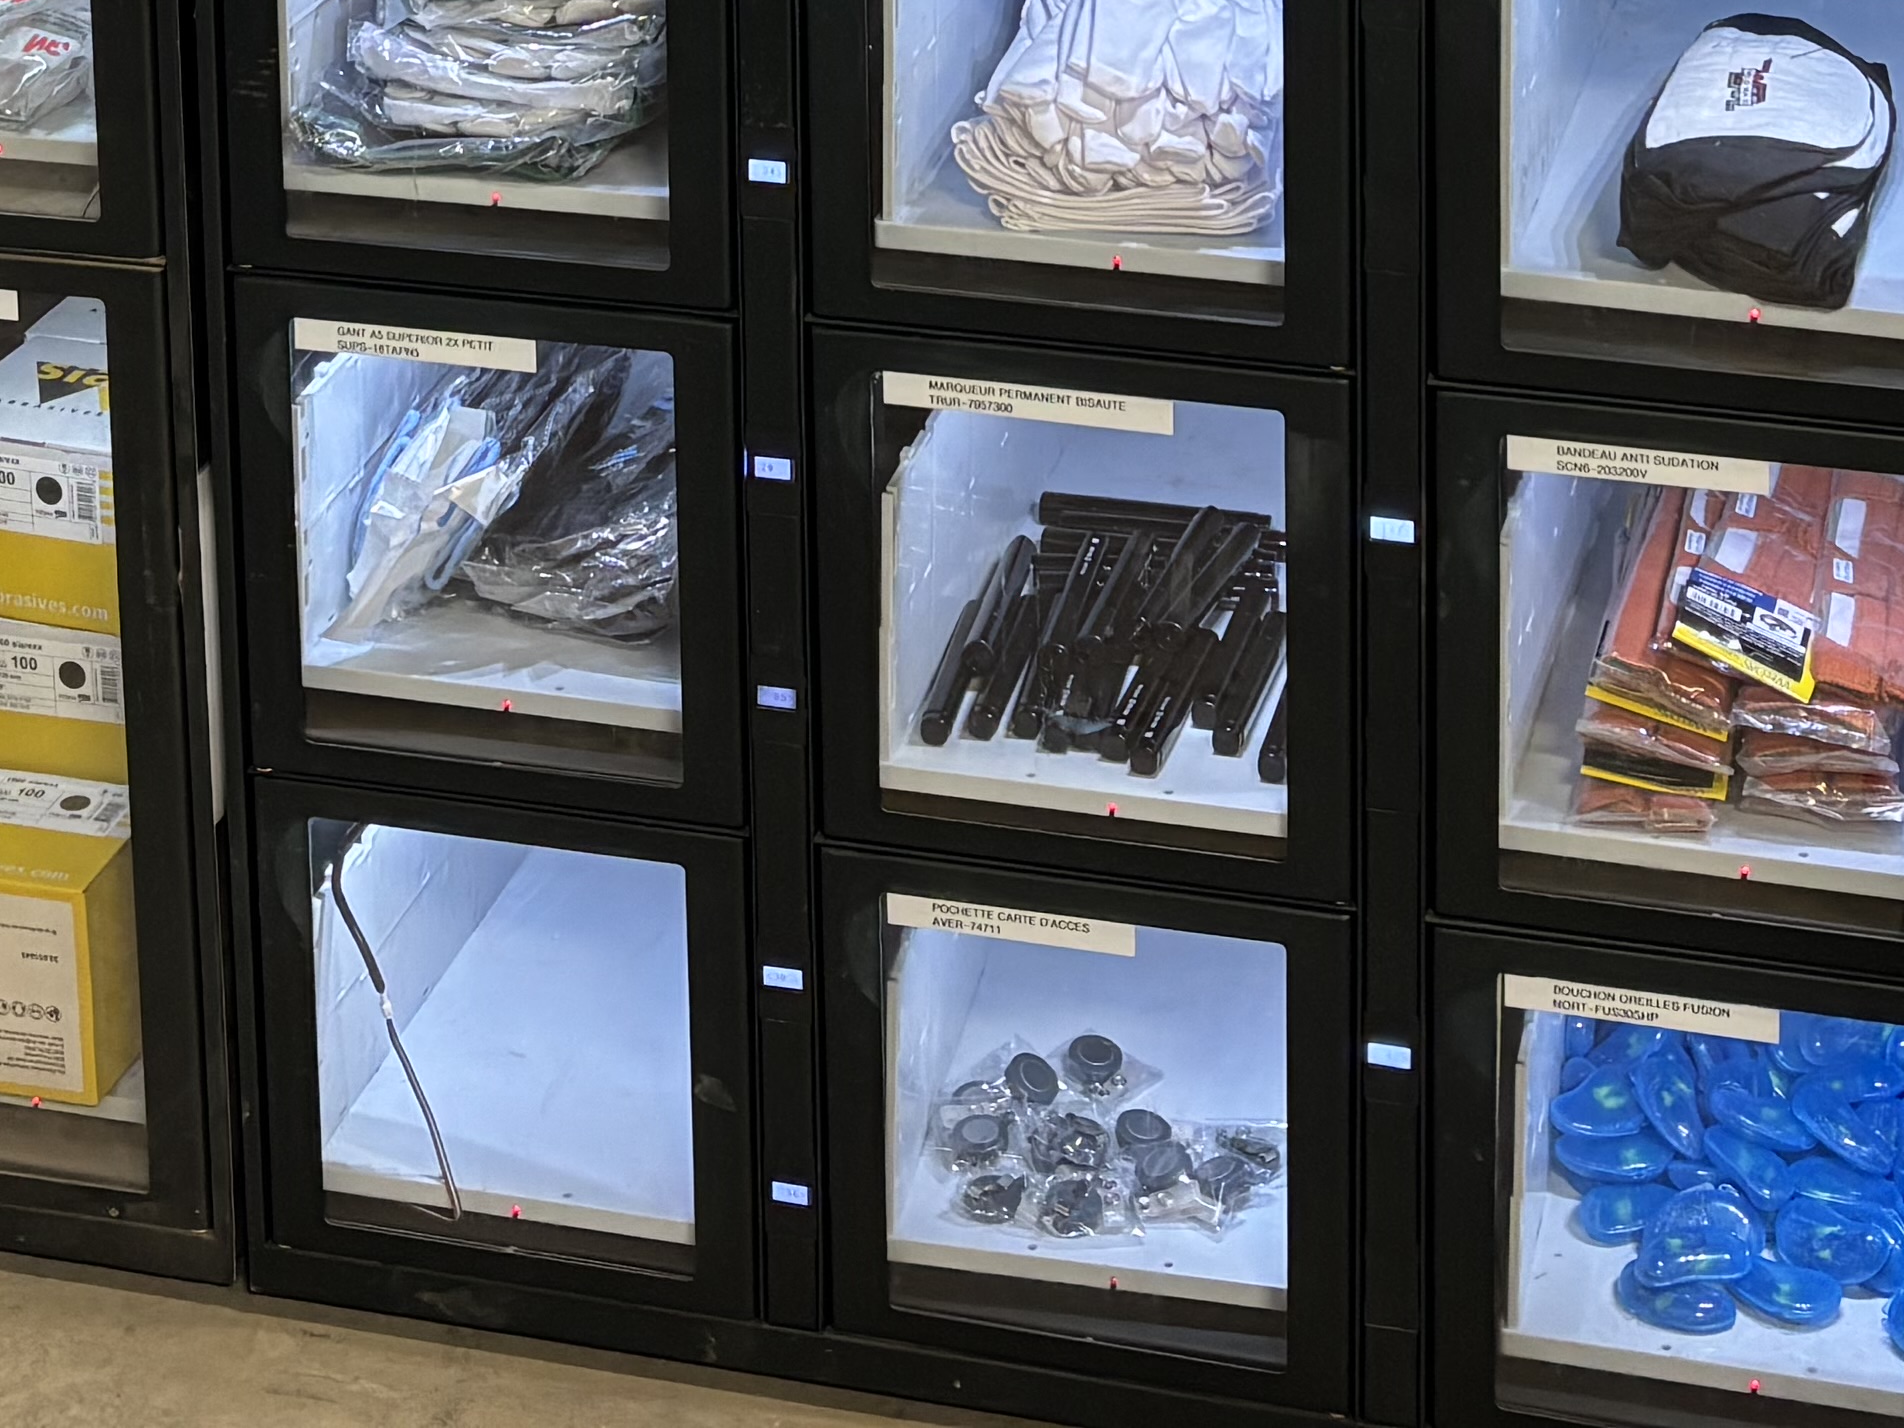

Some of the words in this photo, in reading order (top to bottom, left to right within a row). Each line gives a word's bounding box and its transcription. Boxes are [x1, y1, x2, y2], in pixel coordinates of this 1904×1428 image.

[928, 380, 996, 396] MARQUEUR
[998, 388, 1072, 404] PERMANENT
[1556, 446, 1617, 460] BANDEAU
[1620, 452, 1650, 464] ANTI
[1653, 455, 1719, 470] SUDATION
[11, 655, 38, 671] 100
[931, 903, 994, 919] POCHETTE
[997, 911, 1037, 925] CARTE
